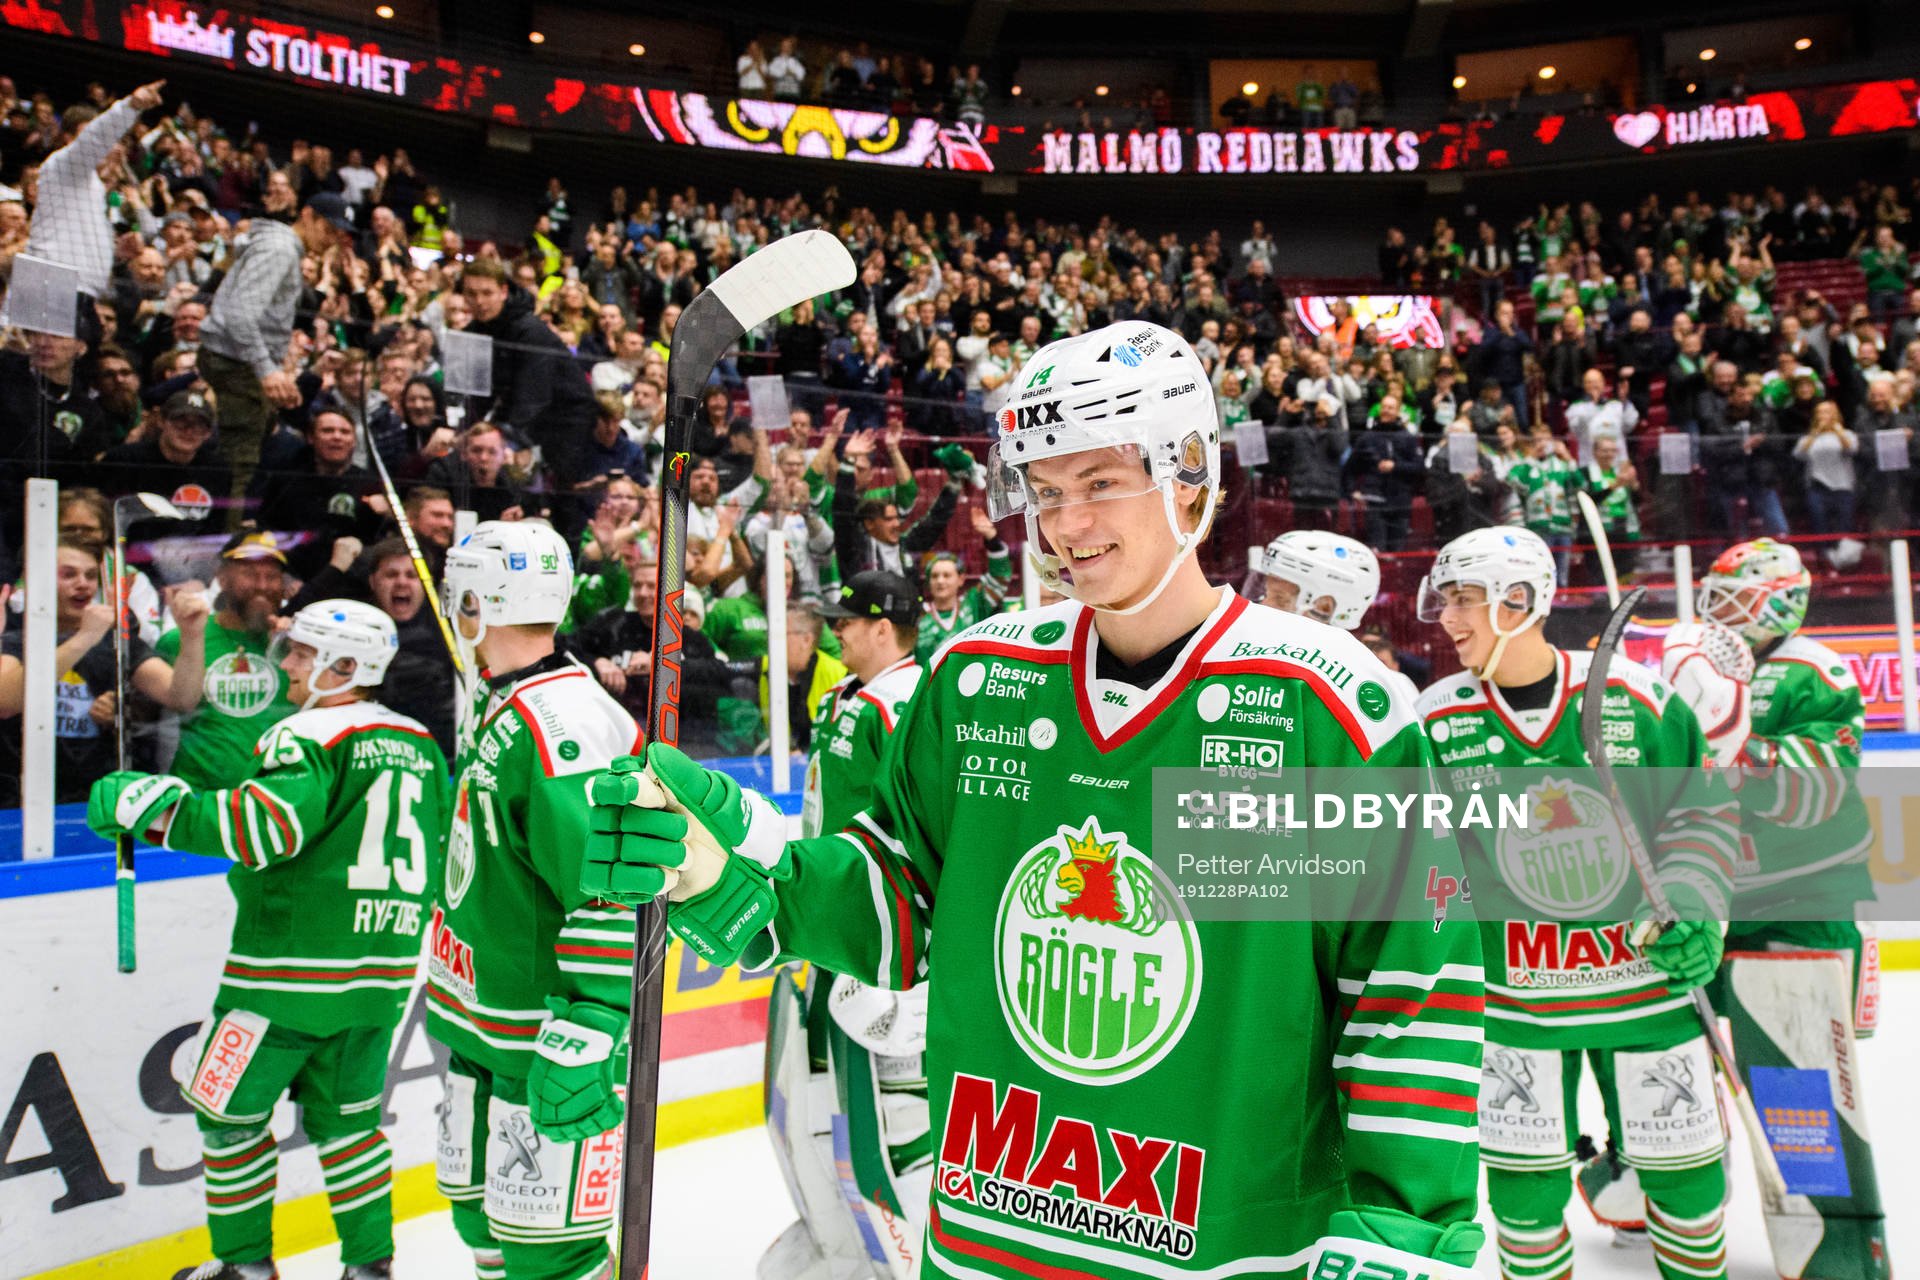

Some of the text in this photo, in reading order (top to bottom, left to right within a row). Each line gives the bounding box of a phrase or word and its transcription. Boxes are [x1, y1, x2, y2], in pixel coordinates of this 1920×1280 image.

[246, 29, 411, 96] STOLTHET
[1666, 103, 1770, 145] HJÄRTA
[1042, 128, 1420, 174] MALMÖ REDHAWKS
[1021, 386, 1053, 400] BAUER
[1162, 383, 1197, 399] BAUER
[1017, 400, 1065, 429] IXX
[990, 662, 1048, 686] Resurs
[1230, 642, 1354, 691] Backahill
[986, 679, 1027, 700] Bank
[1102, 690, 1129, 708] SHL
[1232, 684, 1285, 709] Solid
[1229, 708, 1294, 732] Försäkring
[961, 755, 1027, 777] OTOR
[1204, 741, 1279, 768] ER-HO
[1068, 773, 1130, 790] BAUER
[1218, 764, 1258, 780] BYGG
[347, 769, 428, 895] 15
[725, 902, 760, 942] BAUER
[1017, 926, 1163, 1036] RÖGLE
[201, 1030, 242, 1097] ER-HO
[1480, 1110, 1560, 1128] EUGEOT
[1626, 1109, 1716, 1131] PEUGEOT
[941, 1073, 1204, 1226] MAXI
[938, 1166, 1195, 1257] ICA STORMARKNAD
